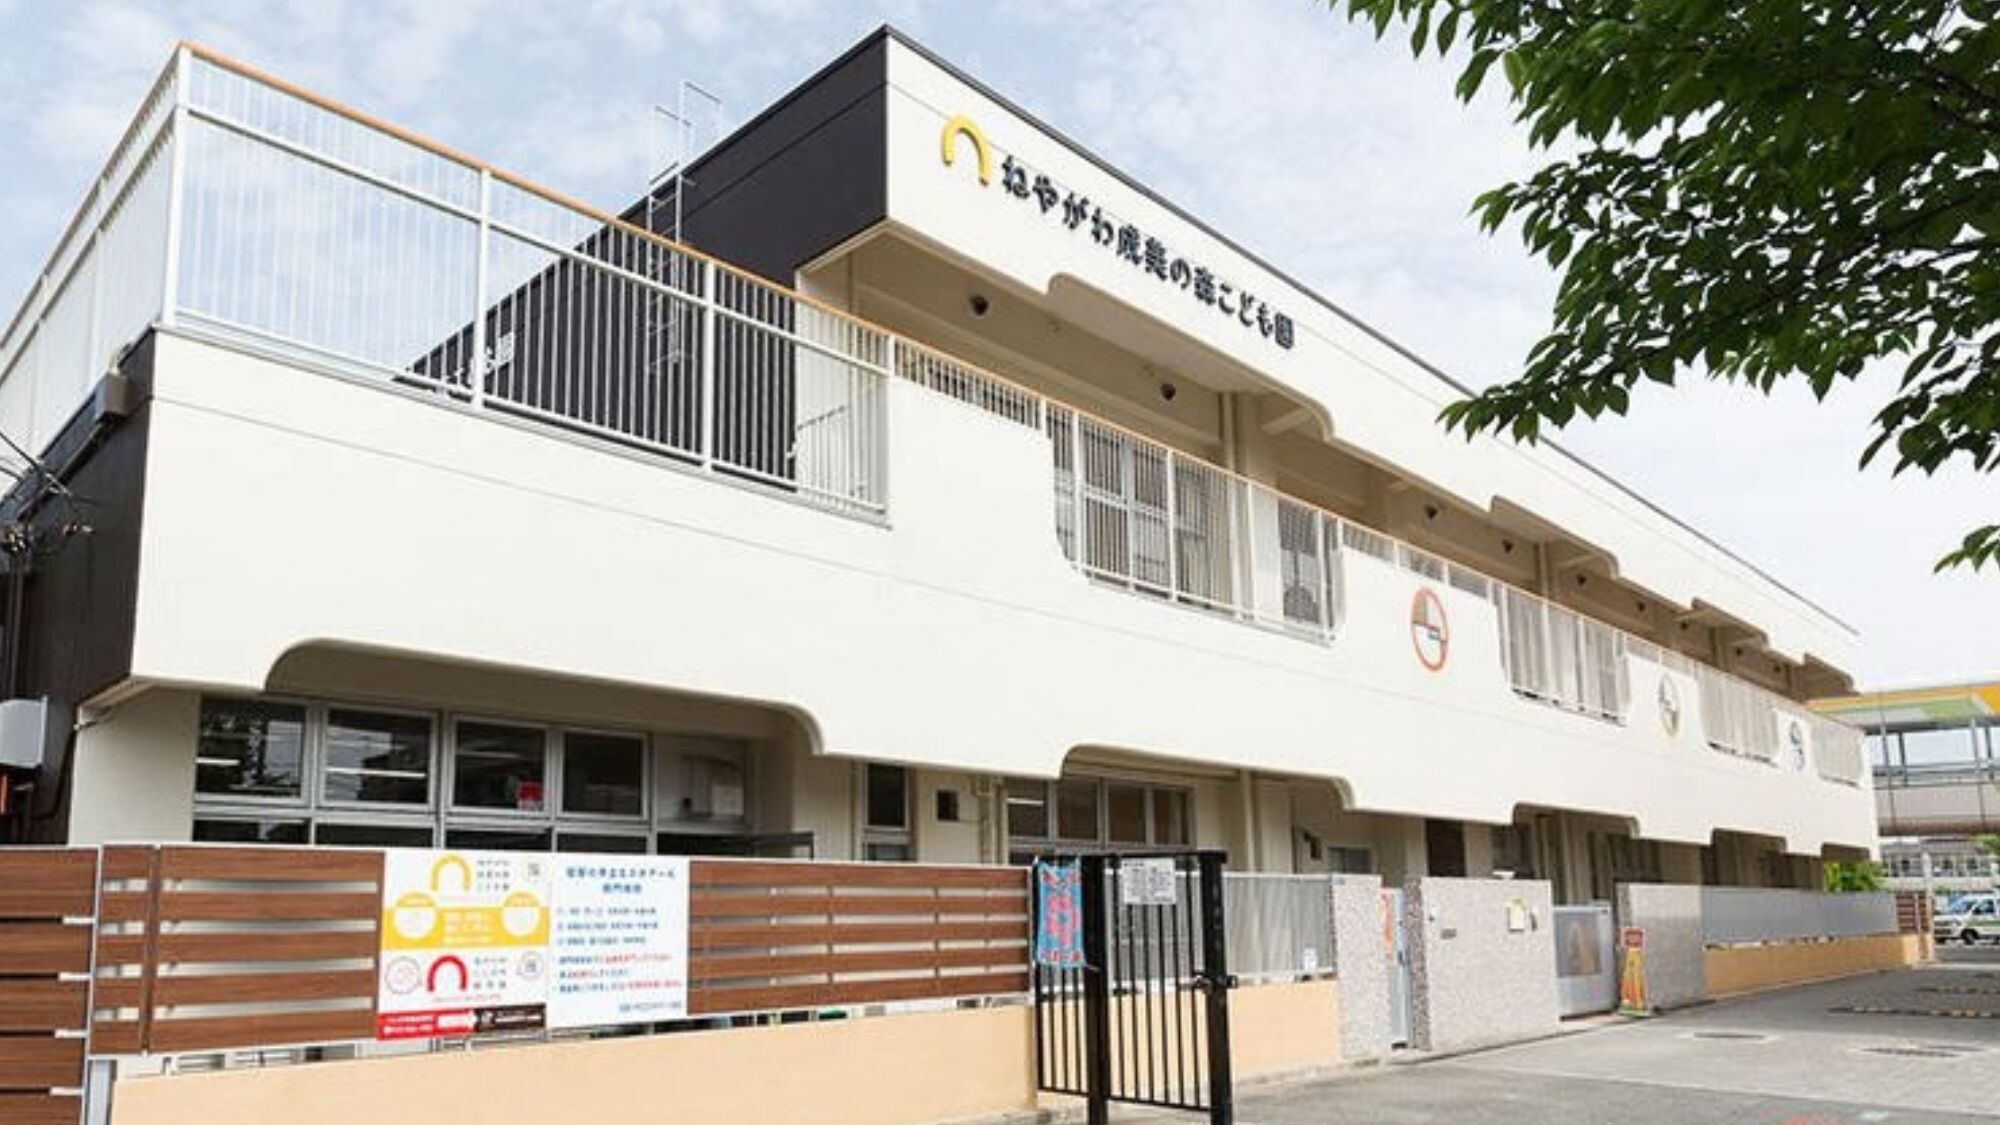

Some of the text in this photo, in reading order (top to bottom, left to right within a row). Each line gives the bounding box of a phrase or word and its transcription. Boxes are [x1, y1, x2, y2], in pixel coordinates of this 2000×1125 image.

[1001, 154, 1295, 350] ねやがわ成美の森こども園
